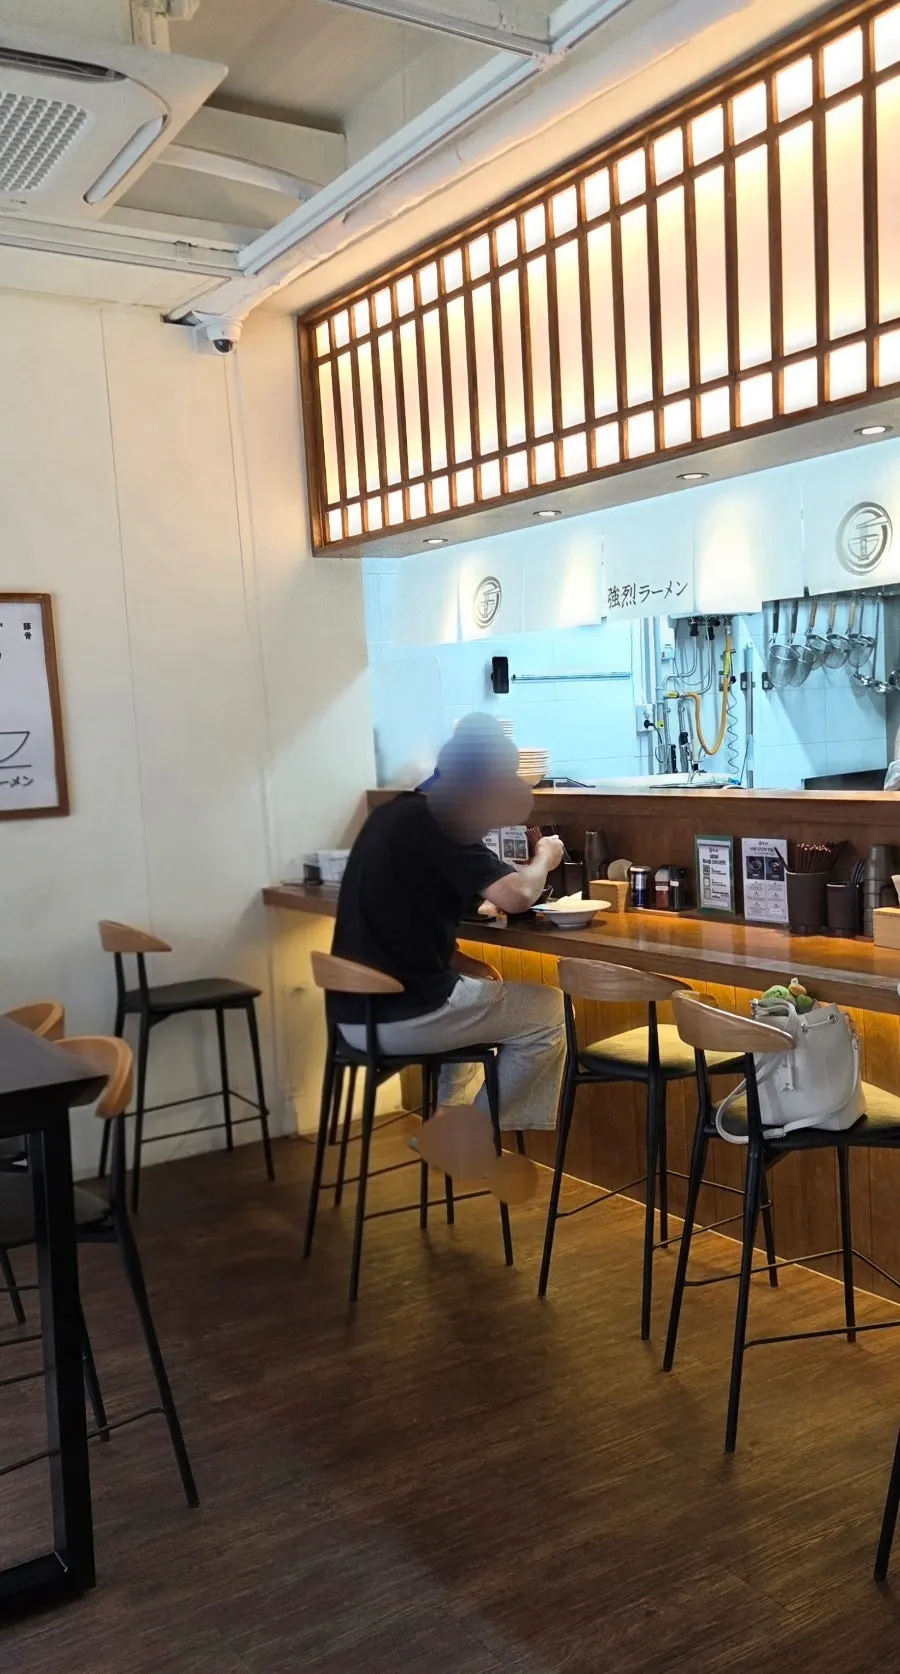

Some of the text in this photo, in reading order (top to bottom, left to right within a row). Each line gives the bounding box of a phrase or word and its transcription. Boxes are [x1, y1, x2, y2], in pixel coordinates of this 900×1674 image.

[608, 580, 688, 609] 強烈ラーメン
